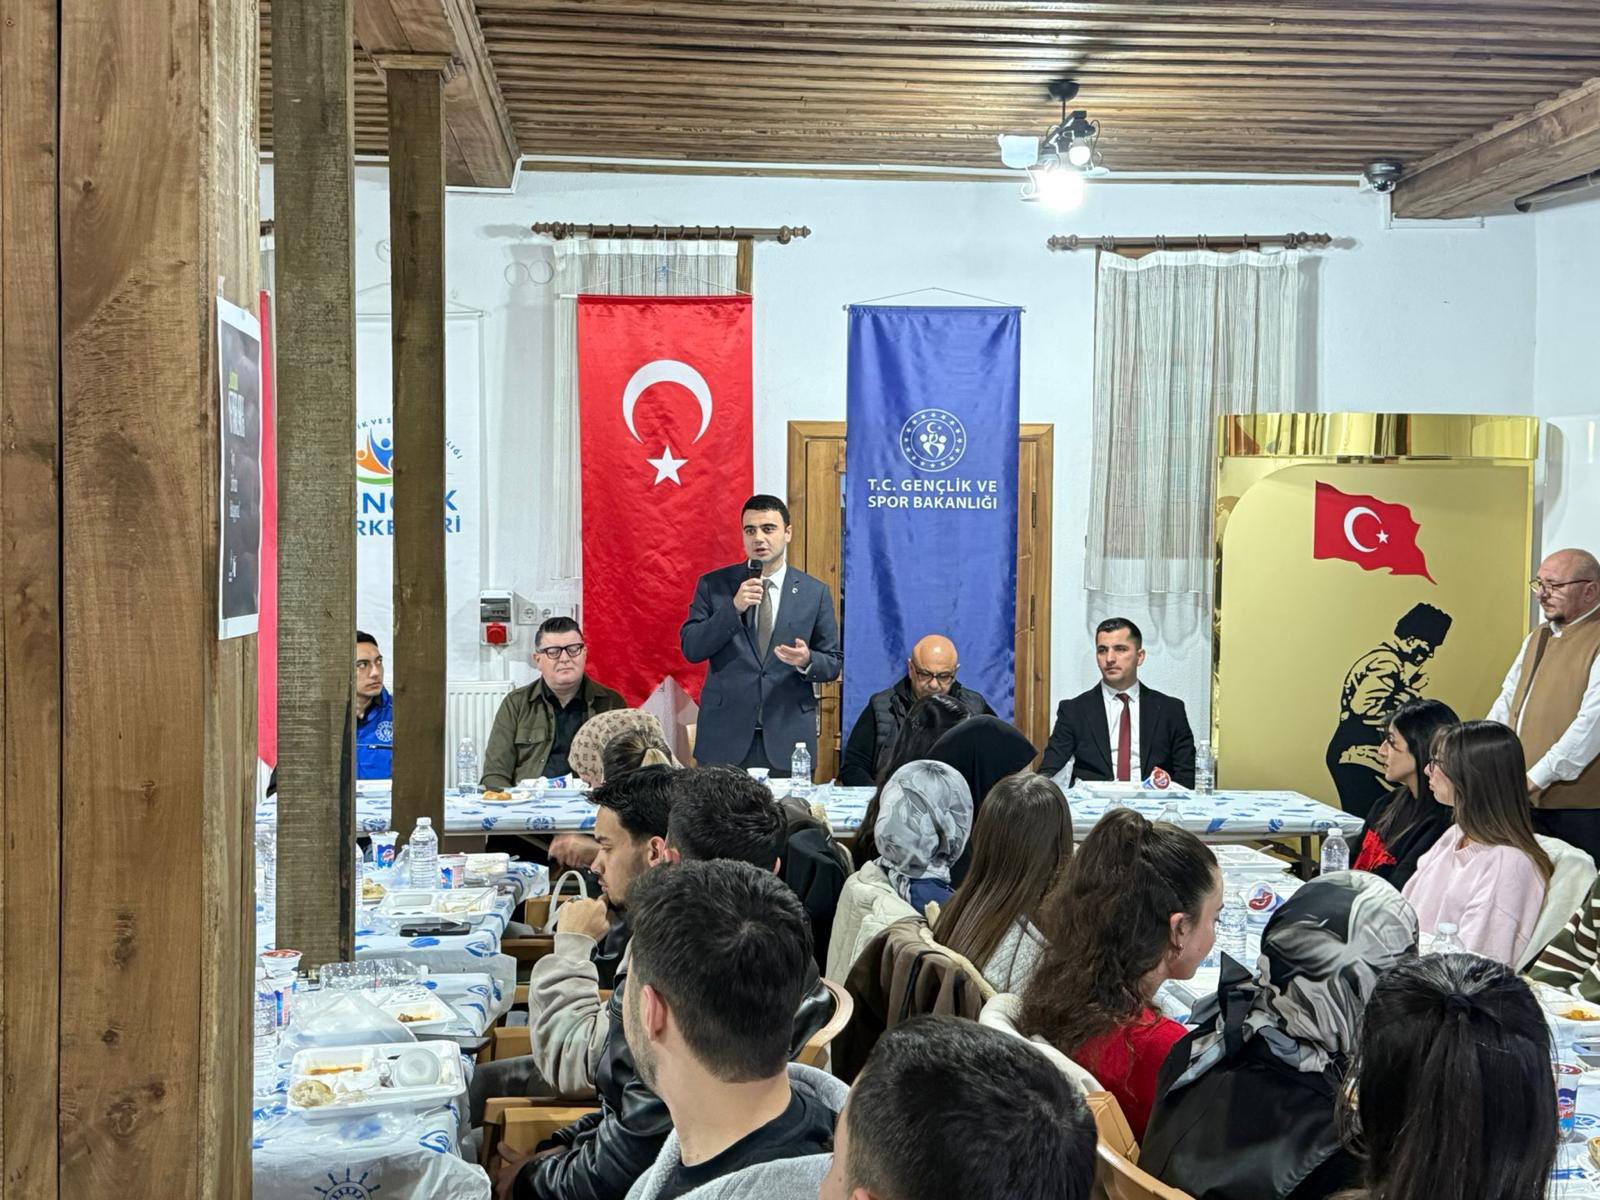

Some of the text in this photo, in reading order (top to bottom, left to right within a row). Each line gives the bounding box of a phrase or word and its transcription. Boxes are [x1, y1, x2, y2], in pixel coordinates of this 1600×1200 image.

[867, 477, 997, 495] T.C. GENÇLİK VE
[867, 495, 998, 509] SPOR BAKANLIĞI
